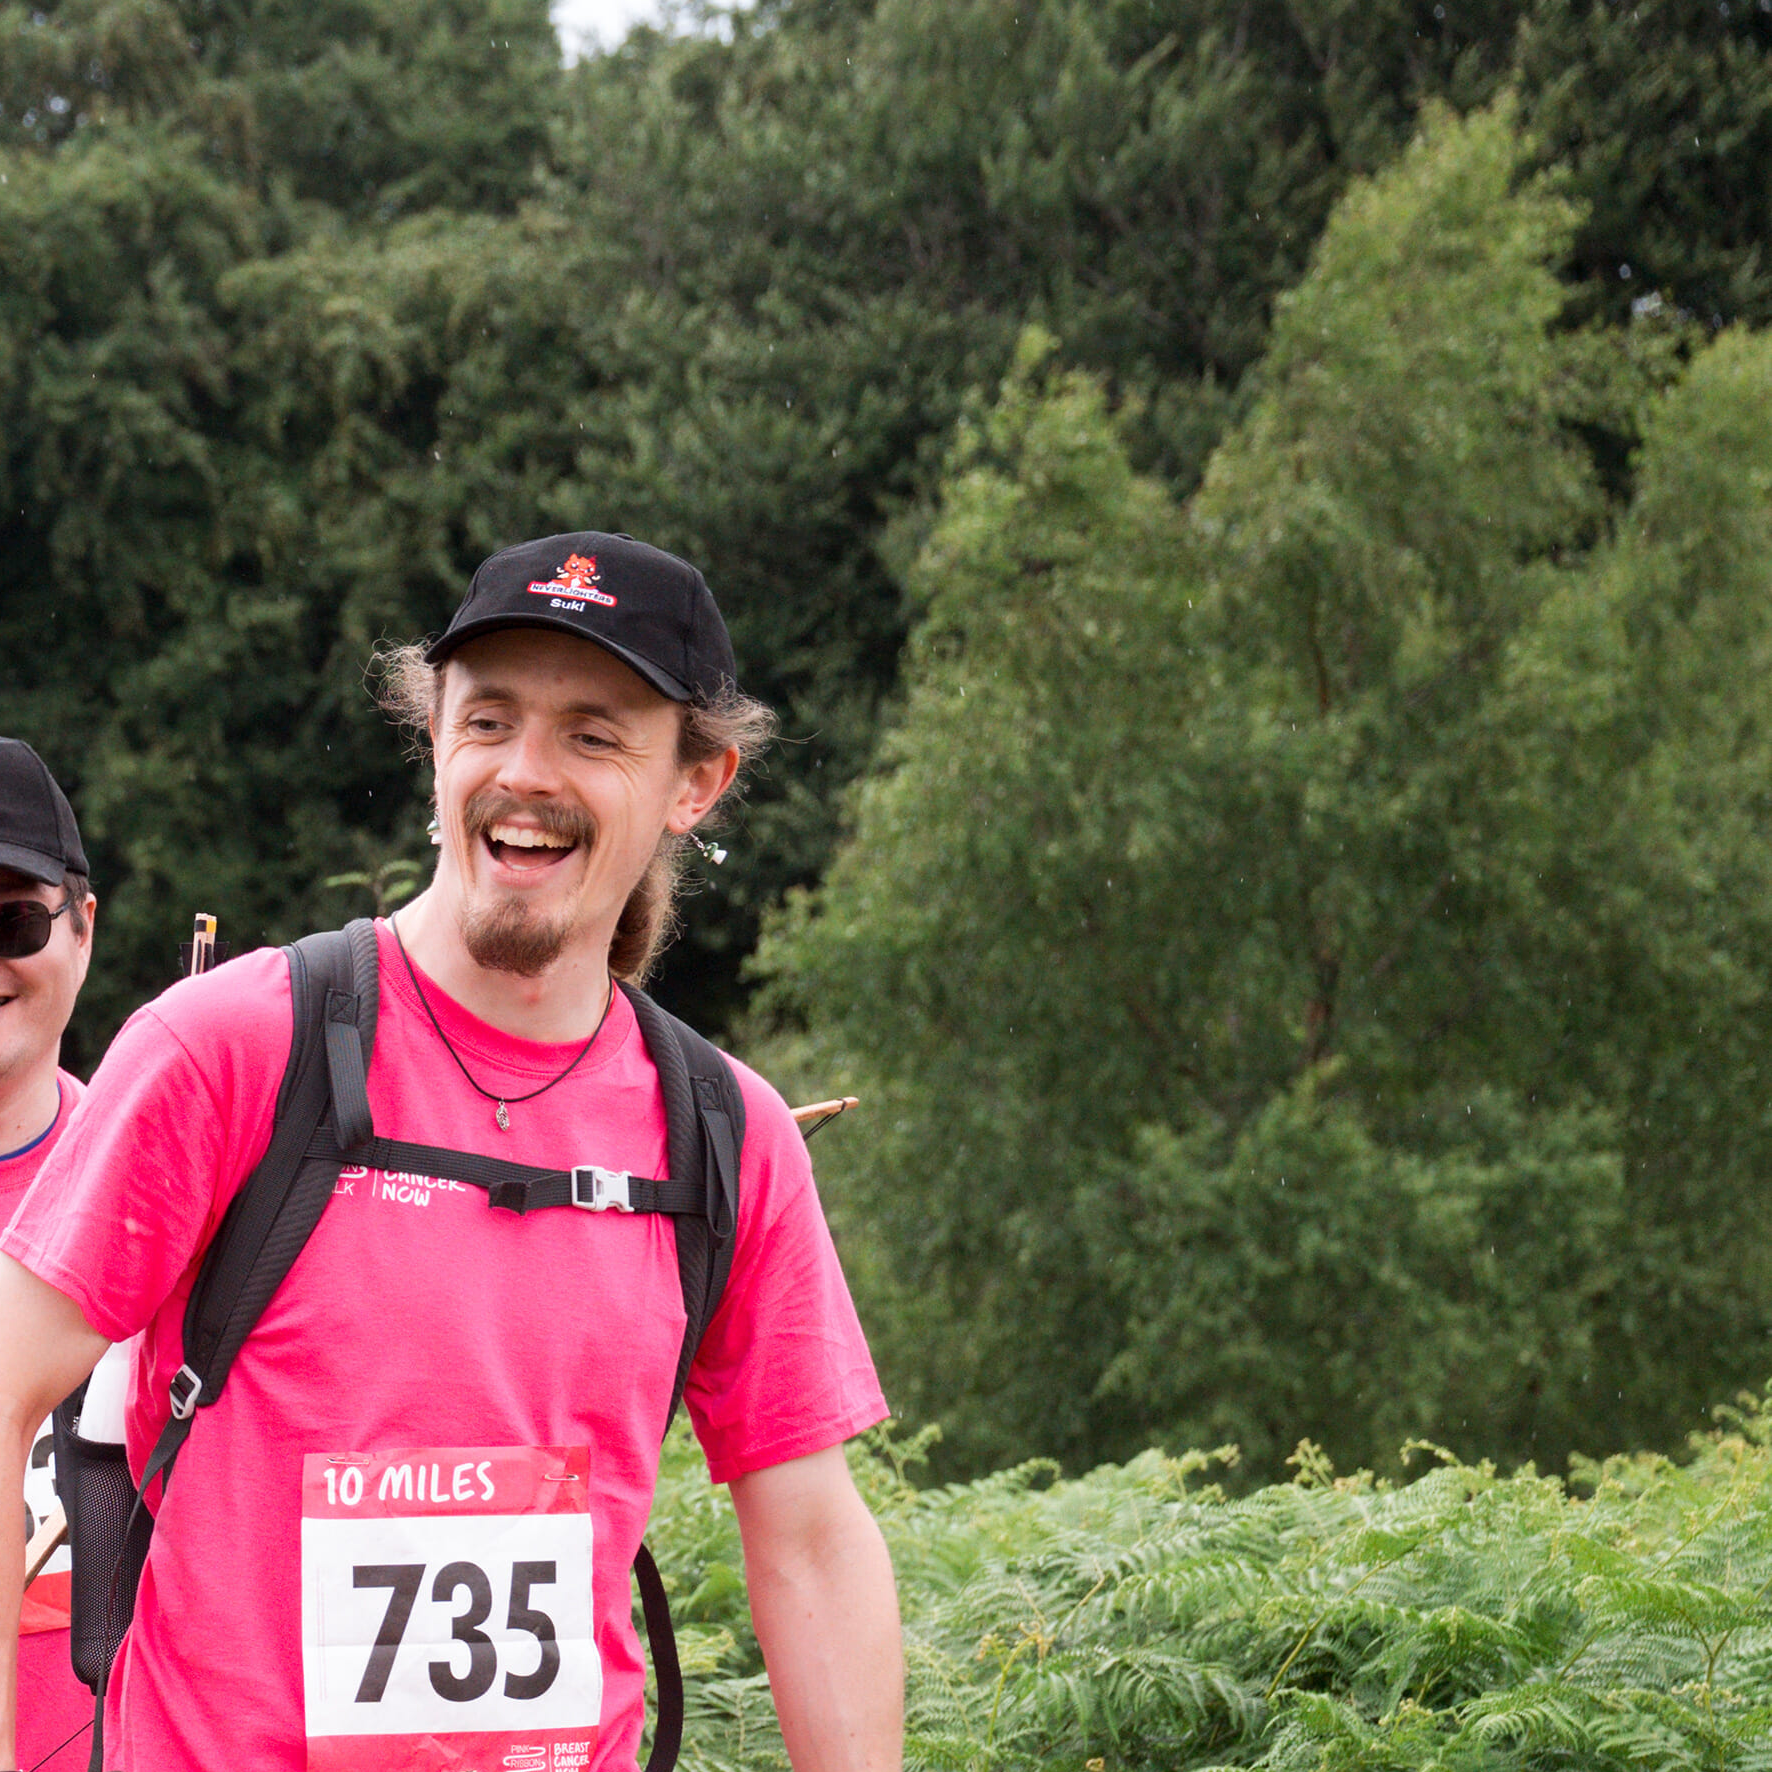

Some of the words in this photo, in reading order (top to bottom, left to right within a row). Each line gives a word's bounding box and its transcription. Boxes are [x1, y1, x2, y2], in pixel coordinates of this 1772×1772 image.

[382, 1182, 430, 1207] NOW
[323, 1466, 364, 1505] 10
[377, 1461, 496, 1504] MILES
[352, 1560, 561, 1703] 735
[553, 1741, 590, 1755] BREAST
[553, 1755, 590, 1768] CANCER
